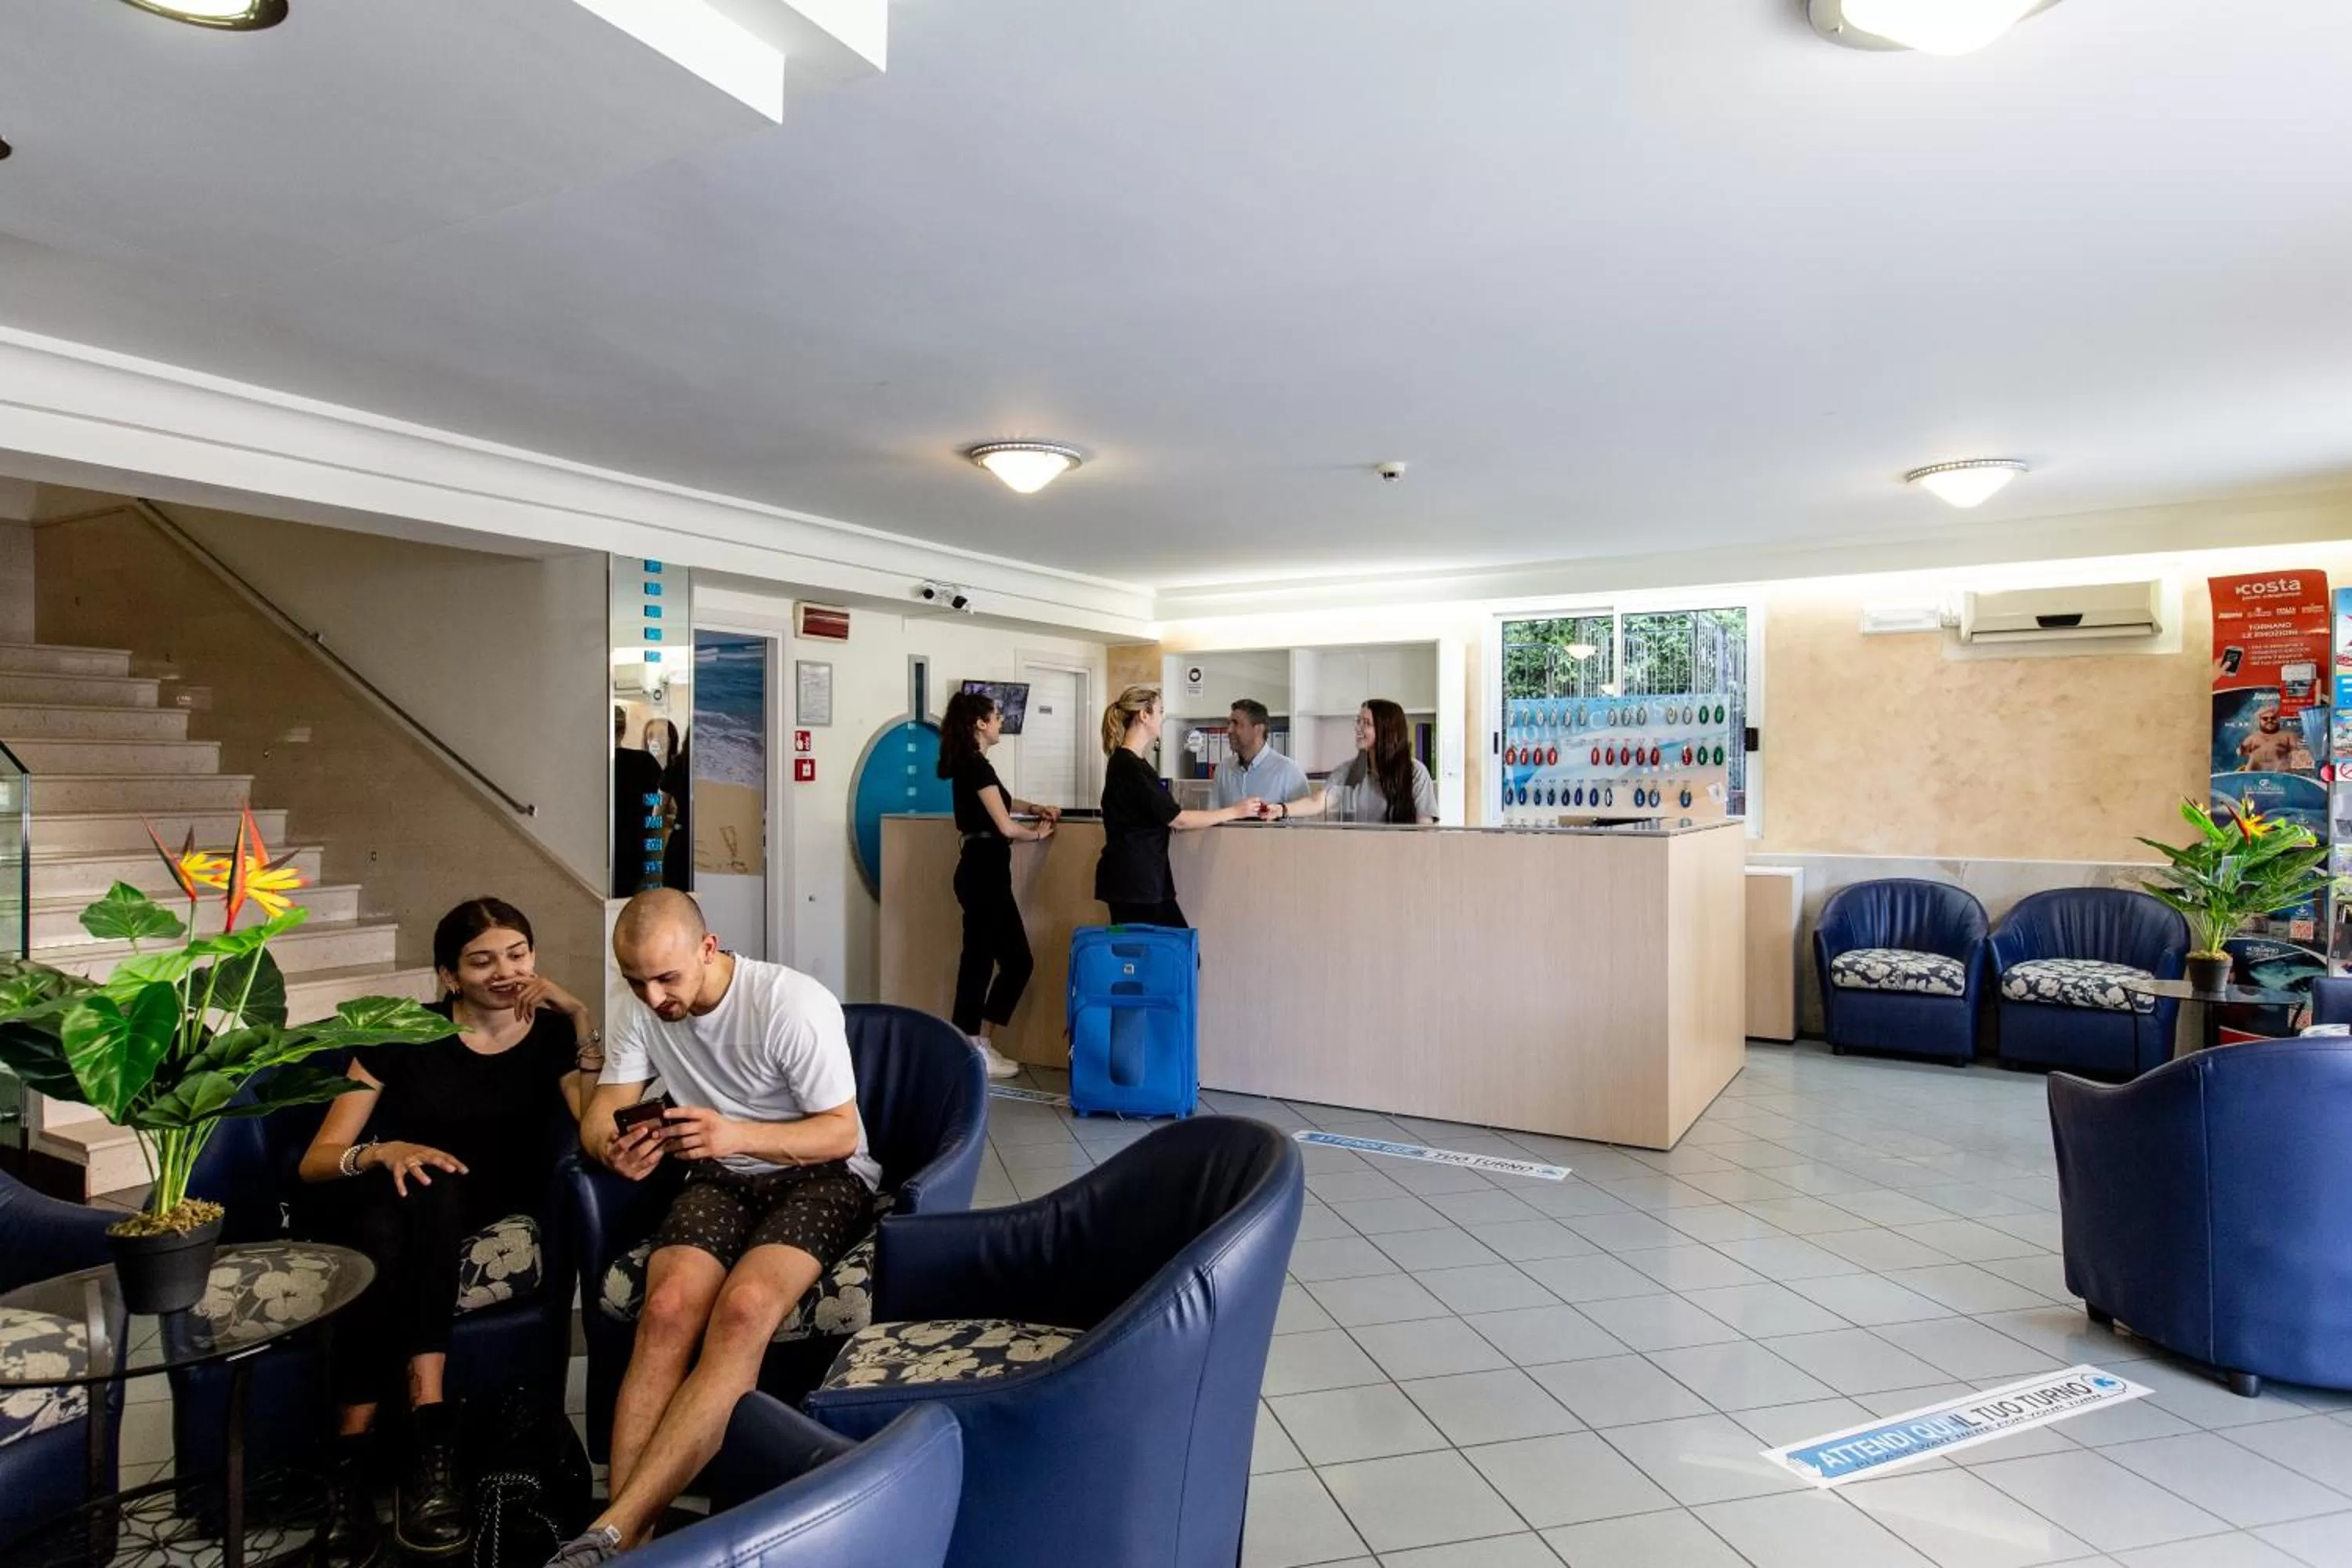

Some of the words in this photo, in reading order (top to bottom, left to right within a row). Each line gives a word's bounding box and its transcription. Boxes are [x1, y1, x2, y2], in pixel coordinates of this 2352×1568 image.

[2241, 578, 2301, 595] costa
[1818, 1428, 1918, 1468] ATTENDI
[1911, 1417, 1958, 1439] QUI
[1969, 1400, 2024, 1422] TUO
[2013, 1381, 2093, 1410] TURNO
